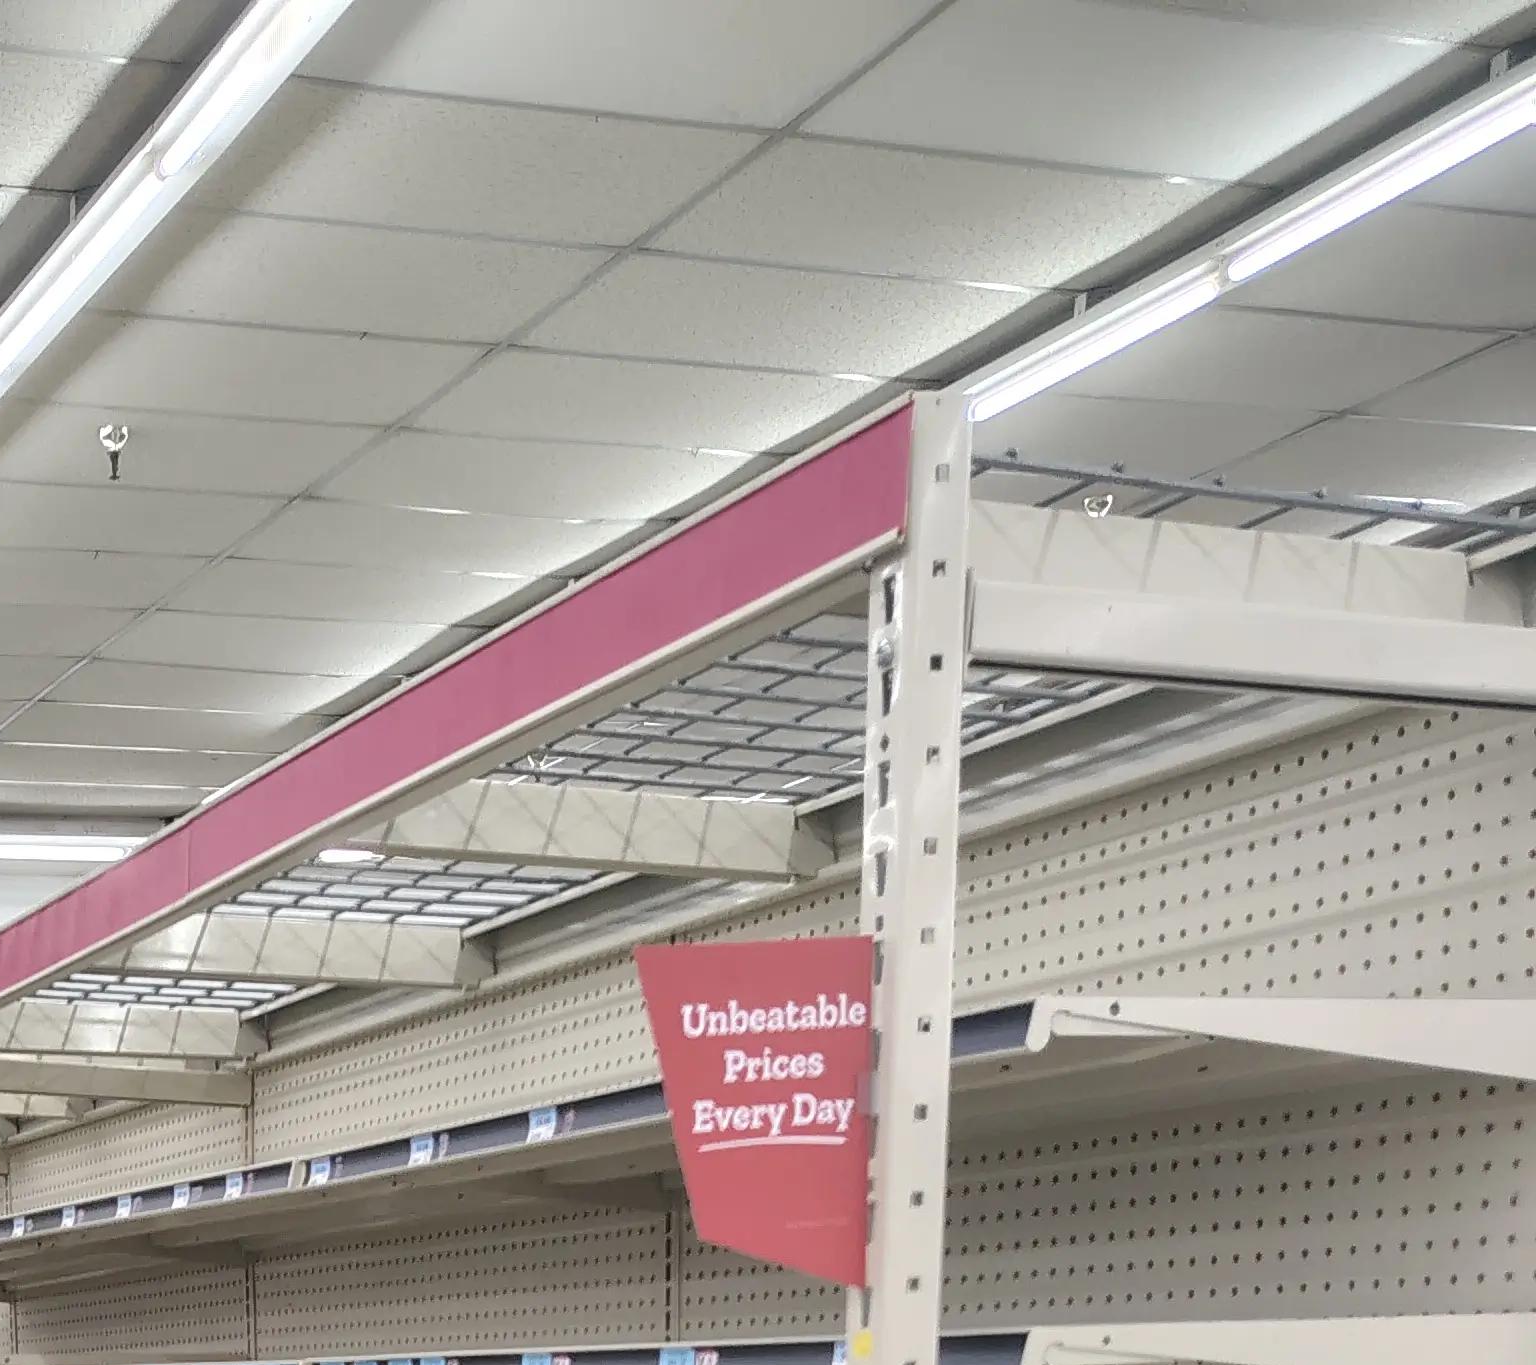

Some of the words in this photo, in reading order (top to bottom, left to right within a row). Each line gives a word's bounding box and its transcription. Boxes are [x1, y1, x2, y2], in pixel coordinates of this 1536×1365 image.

[680, 993, 868, 1038] Unbeatable
[723, 1047, 825, 1084] Prices
[692, 1099, 788, 1137] Every
[791, 1092, 856, 1132] Day
